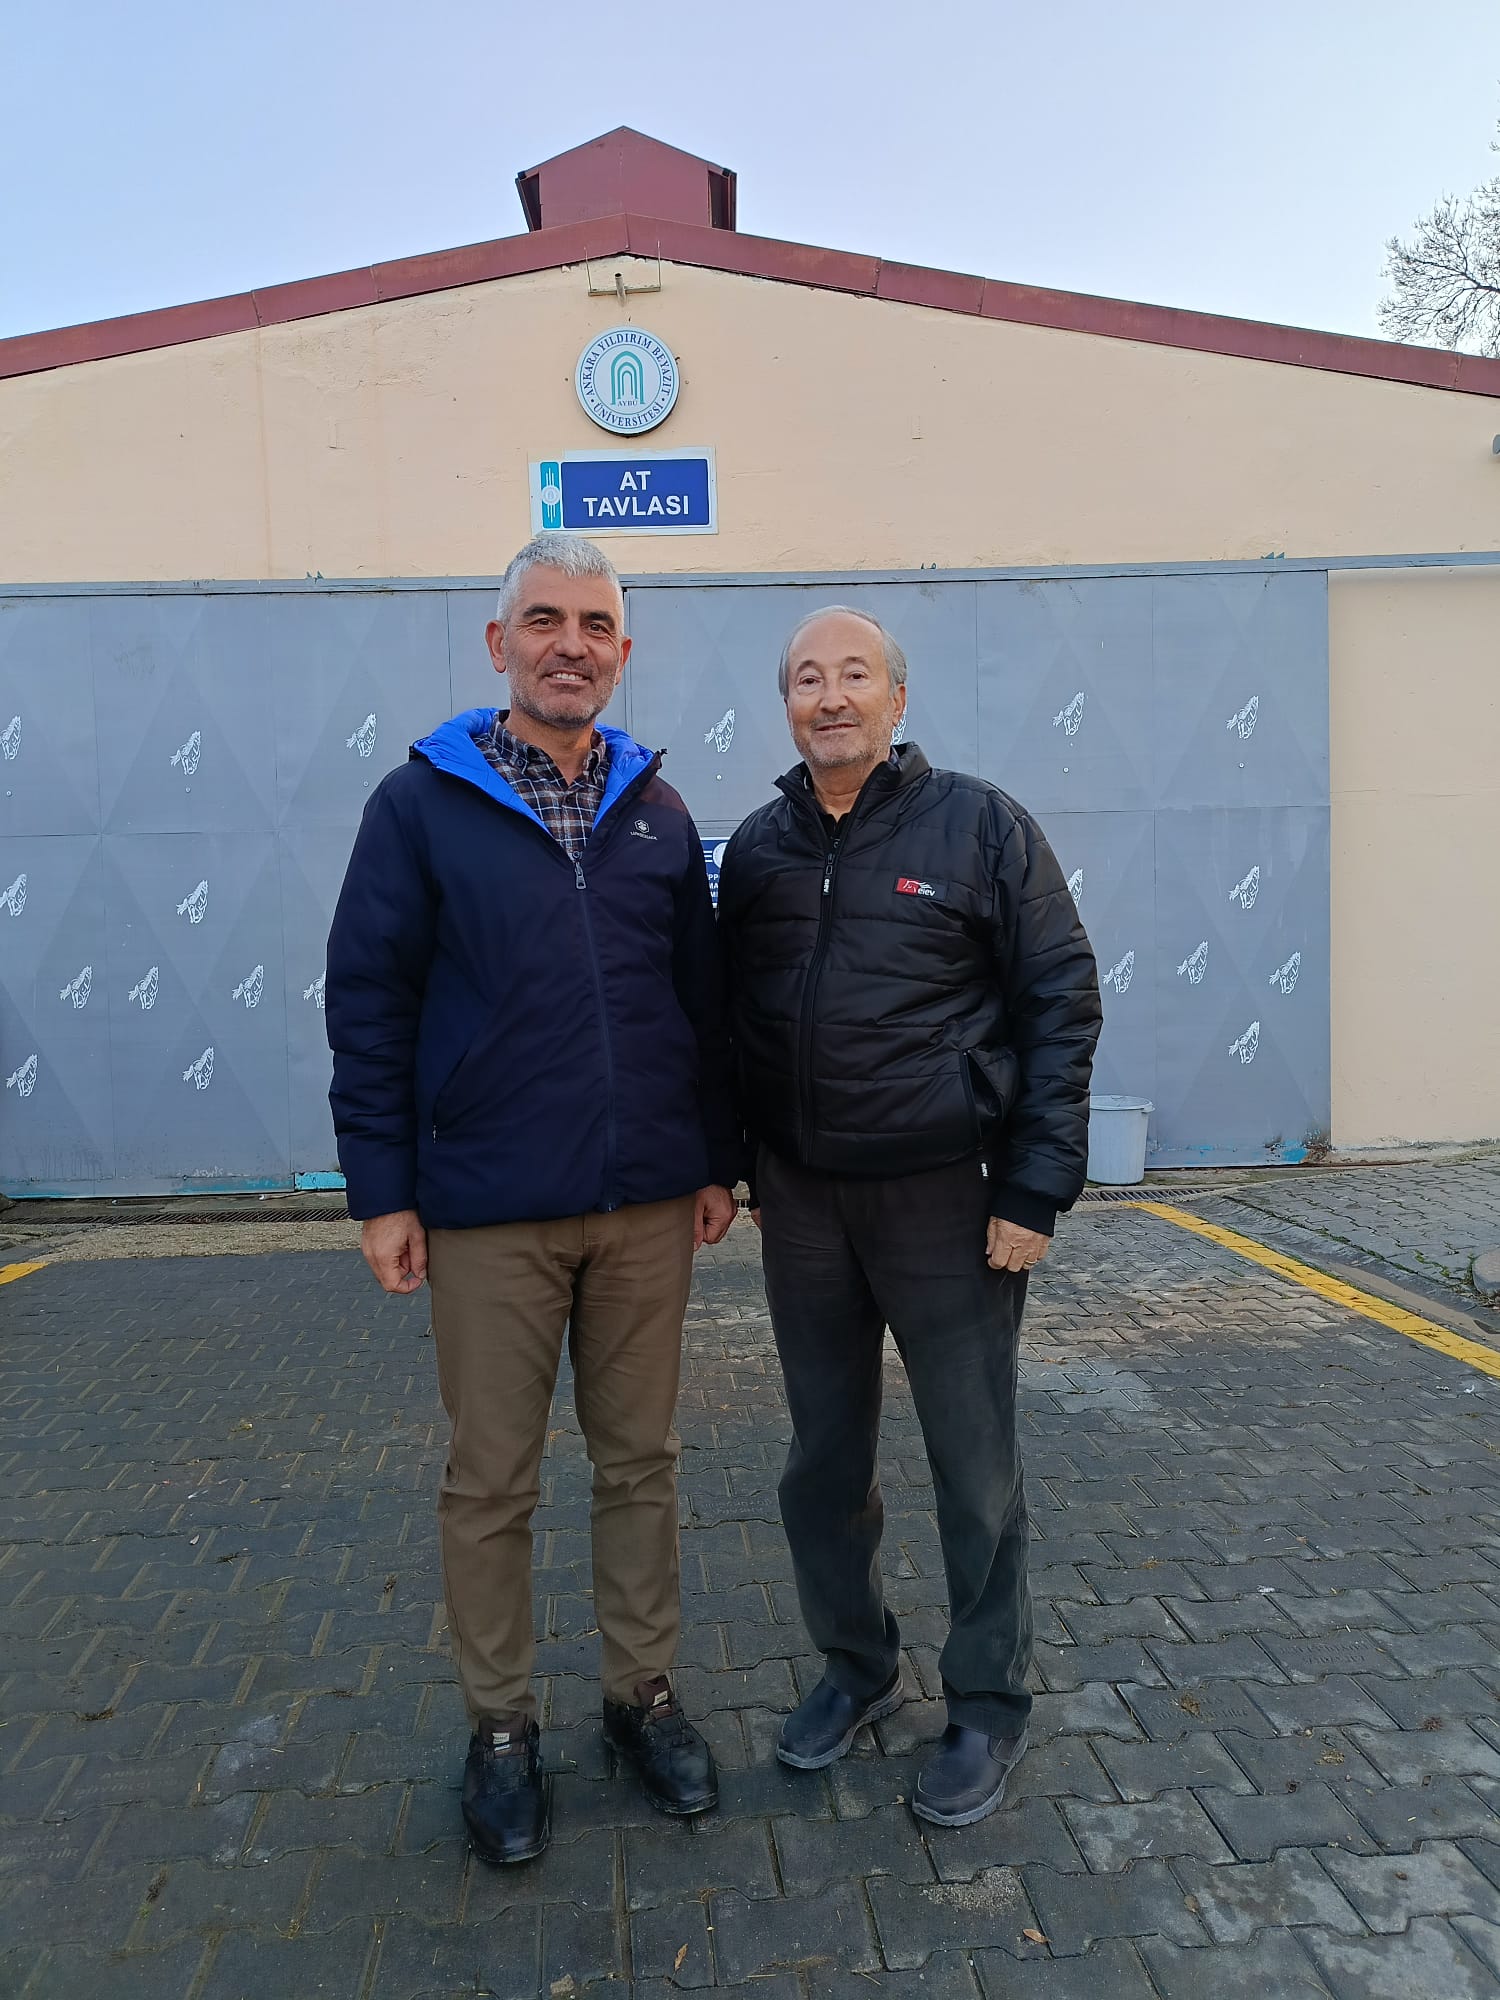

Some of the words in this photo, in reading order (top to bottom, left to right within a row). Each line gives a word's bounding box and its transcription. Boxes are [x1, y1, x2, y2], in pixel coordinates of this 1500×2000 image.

[583, 351, 600, 396] ANKARA
[597, 333, 652, 351] YILDIRIM
[652, 346, 672, 396] BEYAZIT
[593, 401, 664, 427] ÜNİVERSİTESİ
[619, 470, 651, 491] AT
[583, 495, 689, 517] TAVLASI
